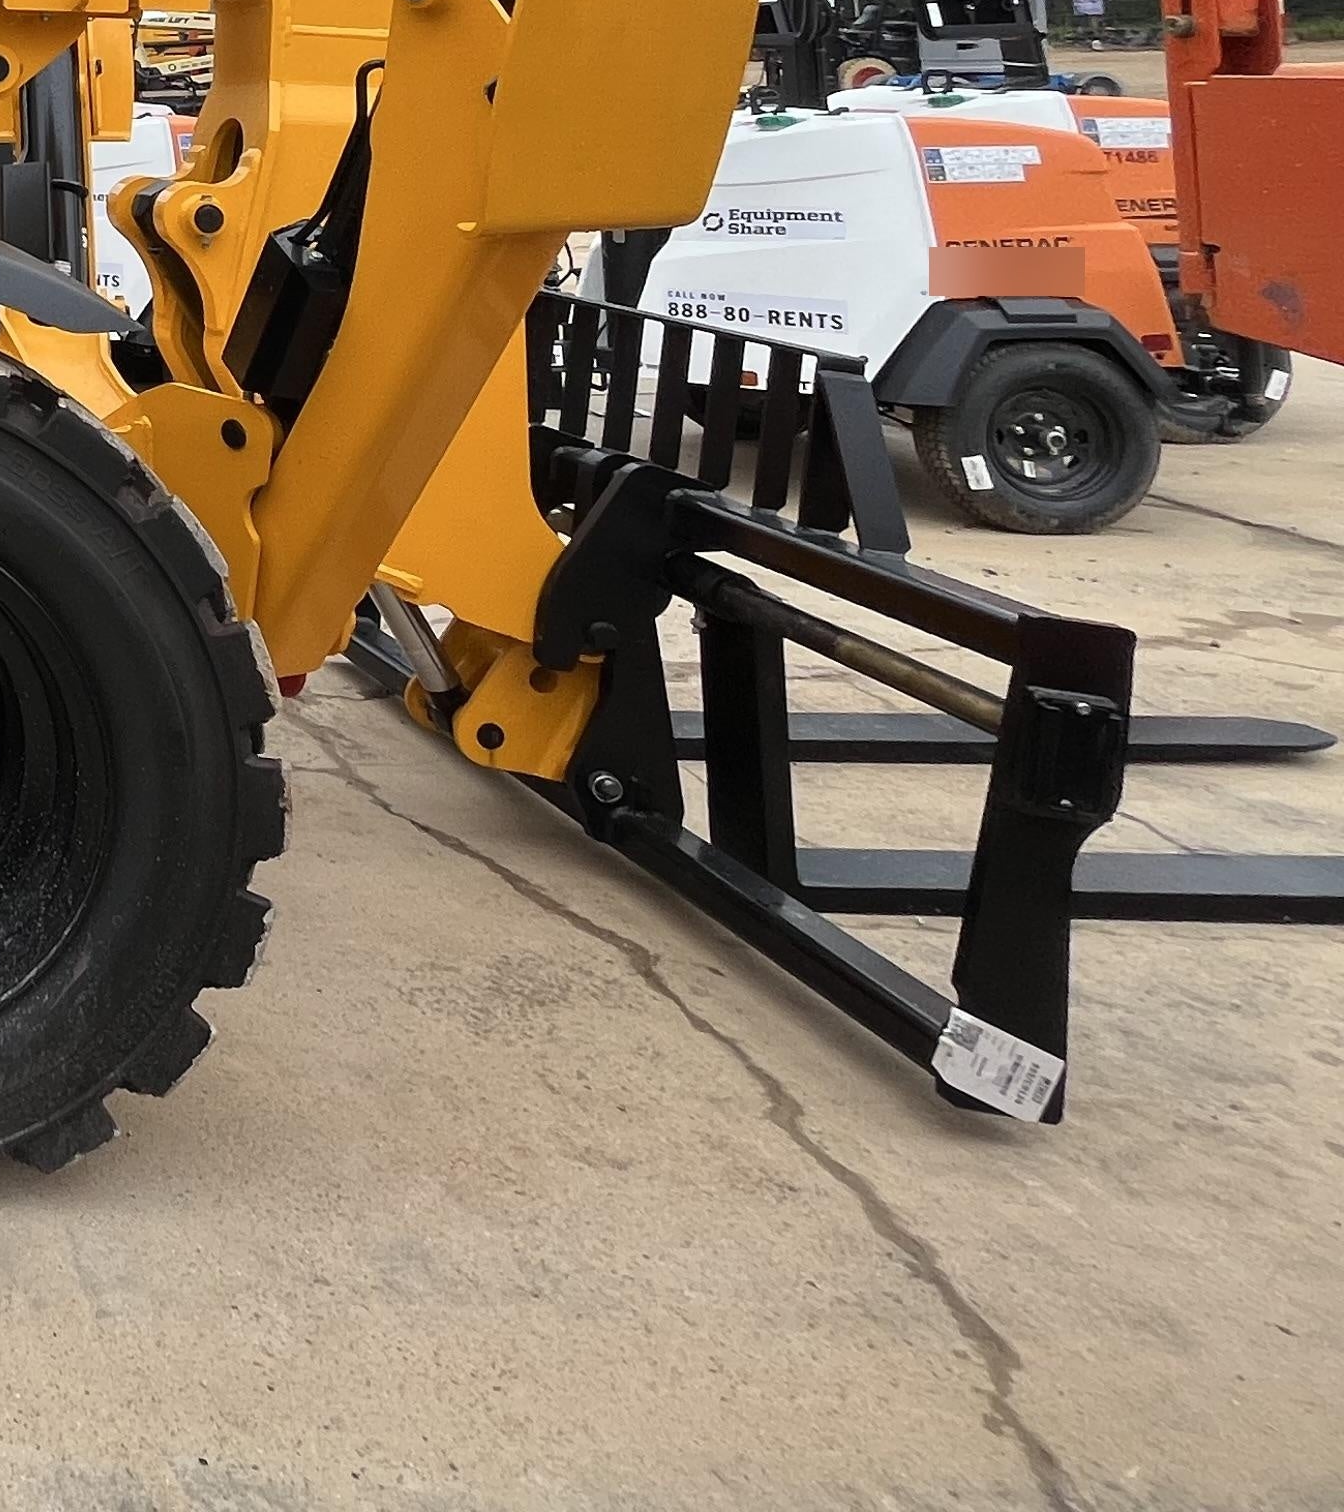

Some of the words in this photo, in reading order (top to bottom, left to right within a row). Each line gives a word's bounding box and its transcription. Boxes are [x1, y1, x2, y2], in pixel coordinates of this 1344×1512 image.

[727, 208, 844, 224] Equipment
[727, 223, 787, 236] Share
[667, 290, 695, 300] CALL
[700, 292, 727, 302] NOW
[667, 301, 844, 331] 888-80-RENTS
